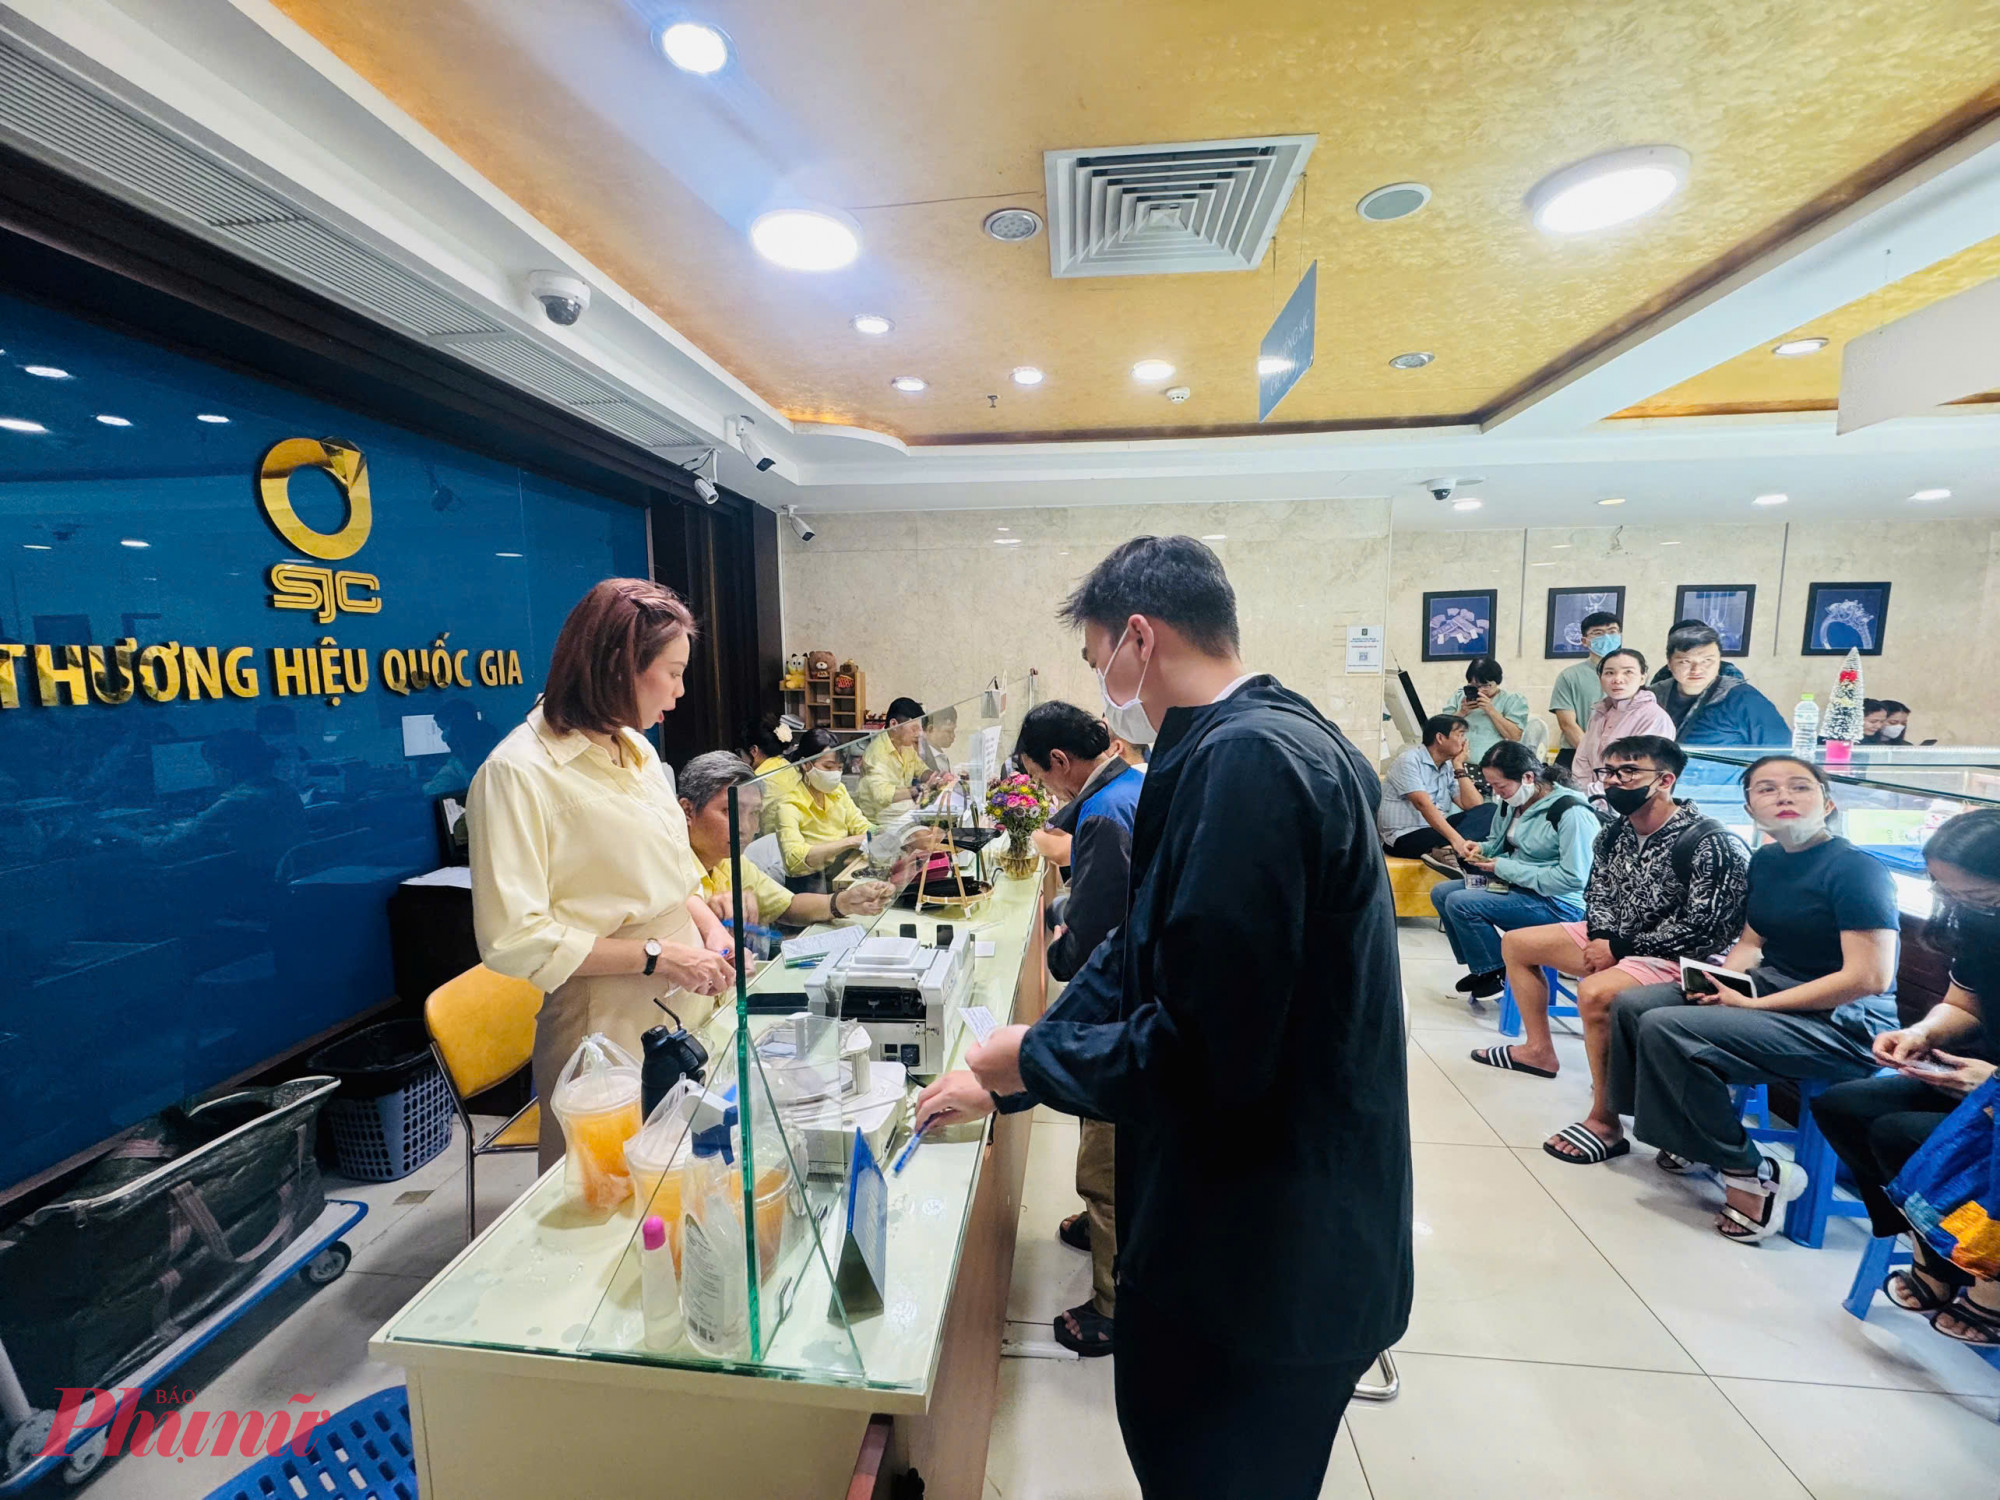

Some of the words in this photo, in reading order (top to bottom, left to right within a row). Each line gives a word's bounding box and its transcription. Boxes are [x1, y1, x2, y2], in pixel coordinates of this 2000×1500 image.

[271, 563, 382, 624] SJC
[0, 637, 260, 709] THƯƠNG
[274, 636, 369, 707] HIỆU
[383, 632, 473, 696] QUỐC
[480, 649, 524, 687] GIA
